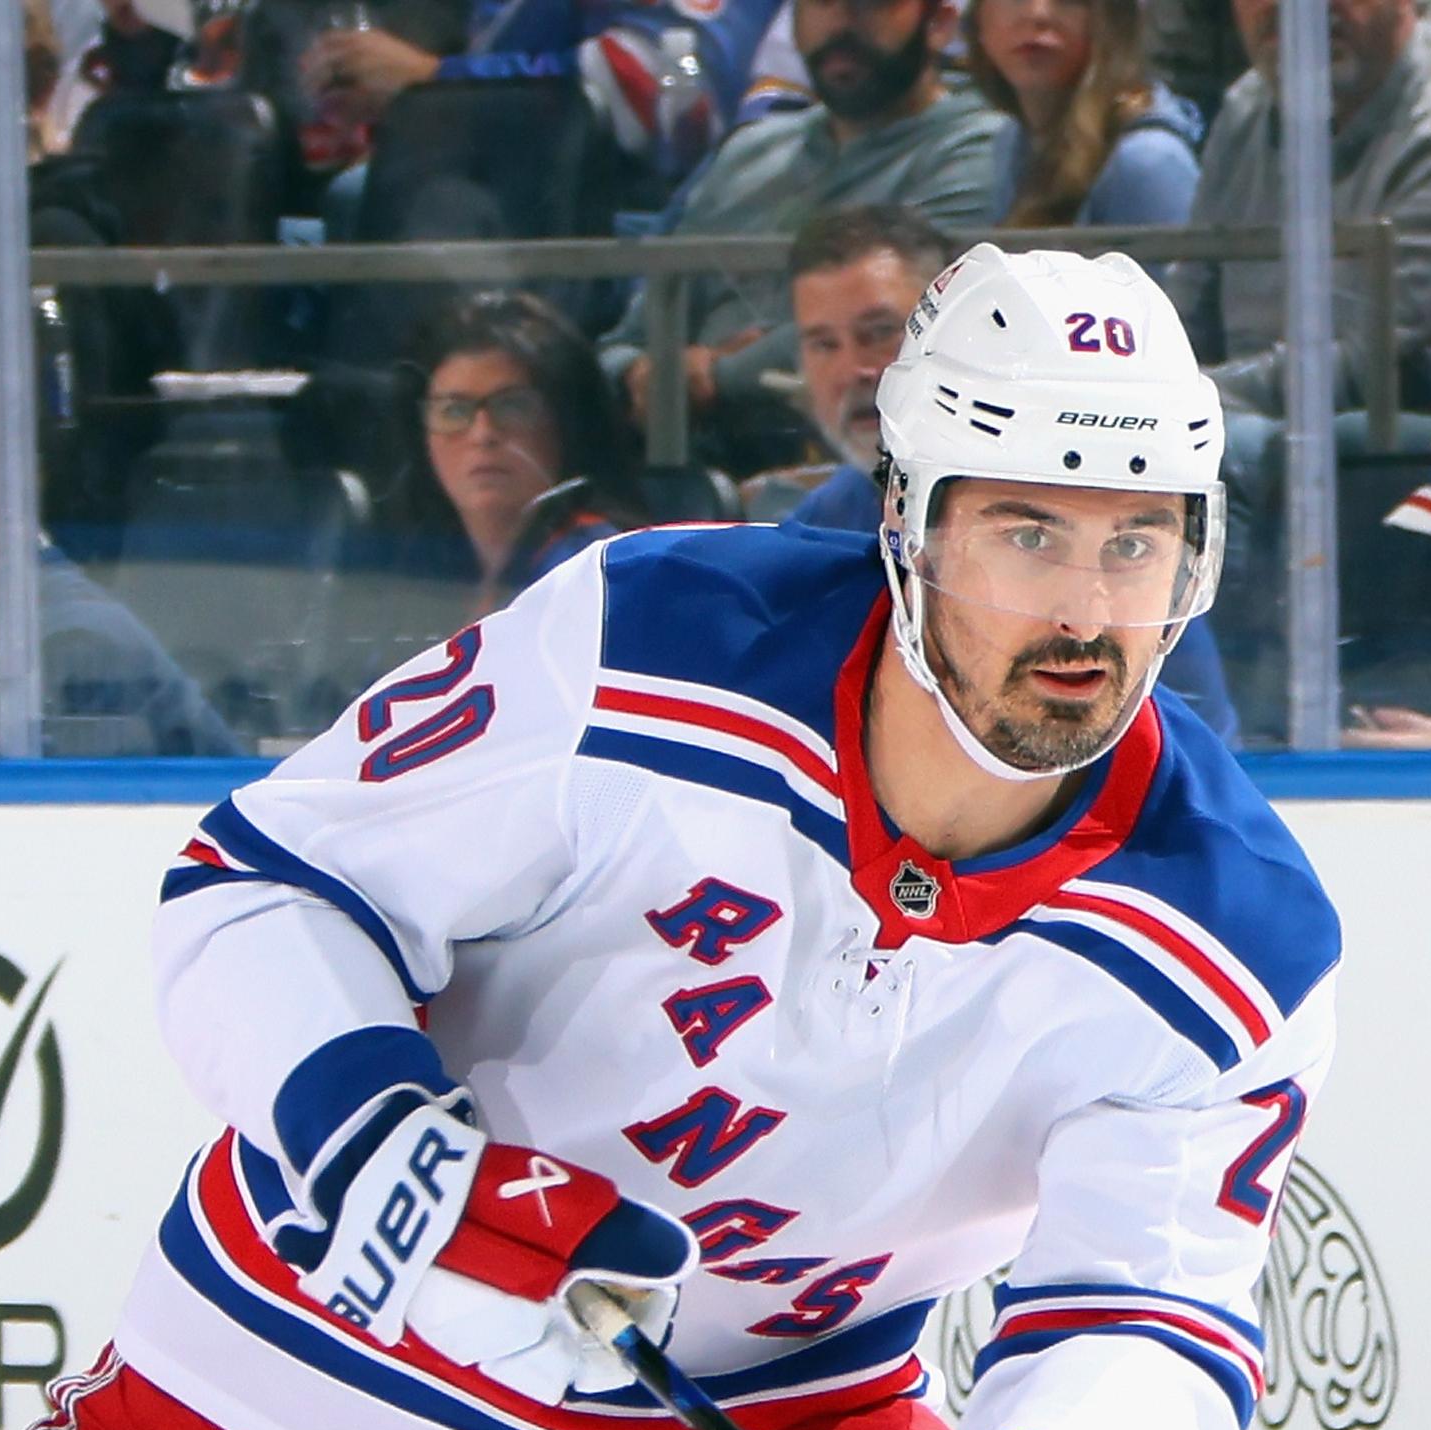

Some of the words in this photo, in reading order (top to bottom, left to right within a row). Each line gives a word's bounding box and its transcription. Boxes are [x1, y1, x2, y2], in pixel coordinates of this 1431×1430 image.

[1065, 312, 1136, 357] 20
[357, 623, 497, 783] 20
[897, 886, 930, 899] NHL
[1215, 1077, 1308, 1228] 2
